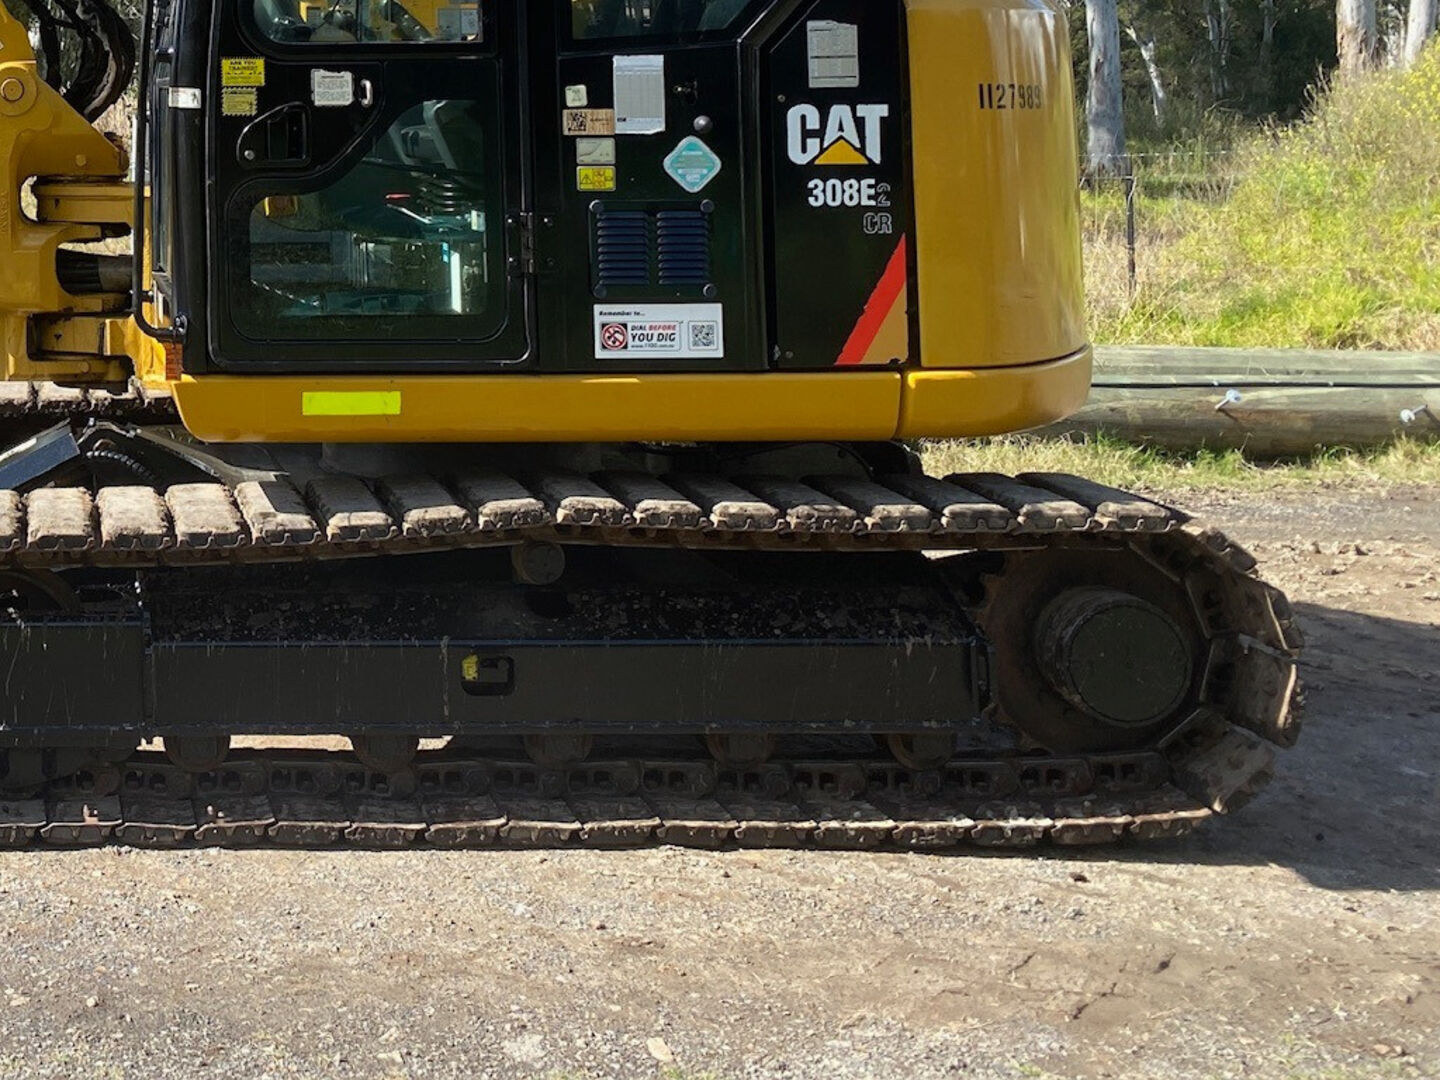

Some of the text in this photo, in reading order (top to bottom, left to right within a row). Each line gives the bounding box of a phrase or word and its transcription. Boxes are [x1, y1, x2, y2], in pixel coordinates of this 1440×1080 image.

[786, 104, 889, 165] CAT
[807, 178, 891, 208] 308E2
[863, 212, 893, 234] CR
[631, 333, 676, 342] YOU DIG
